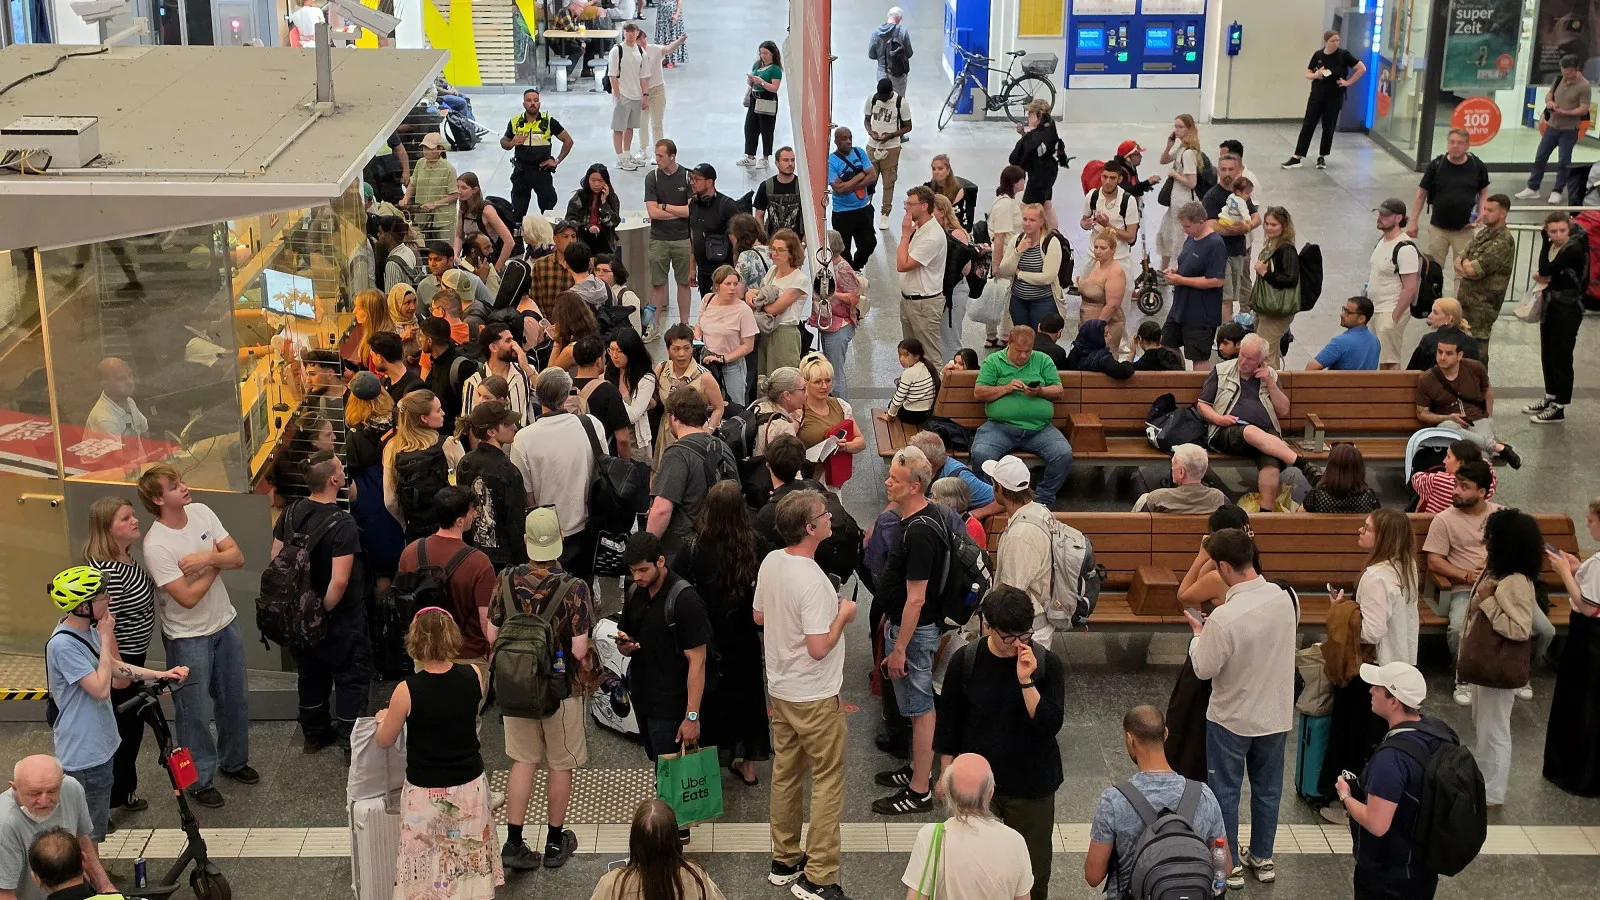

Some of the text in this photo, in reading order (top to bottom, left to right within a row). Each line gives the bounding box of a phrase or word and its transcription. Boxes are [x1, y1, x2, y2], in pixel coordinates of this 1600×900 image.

[1456, 9, 1494, 21] super
[1454, 21, 1482, 34] Zeit
[1464, 113, 1489, 126] 100
[681, 775, 706, 790] Uber
[683, 788, 709, 803] Eats
